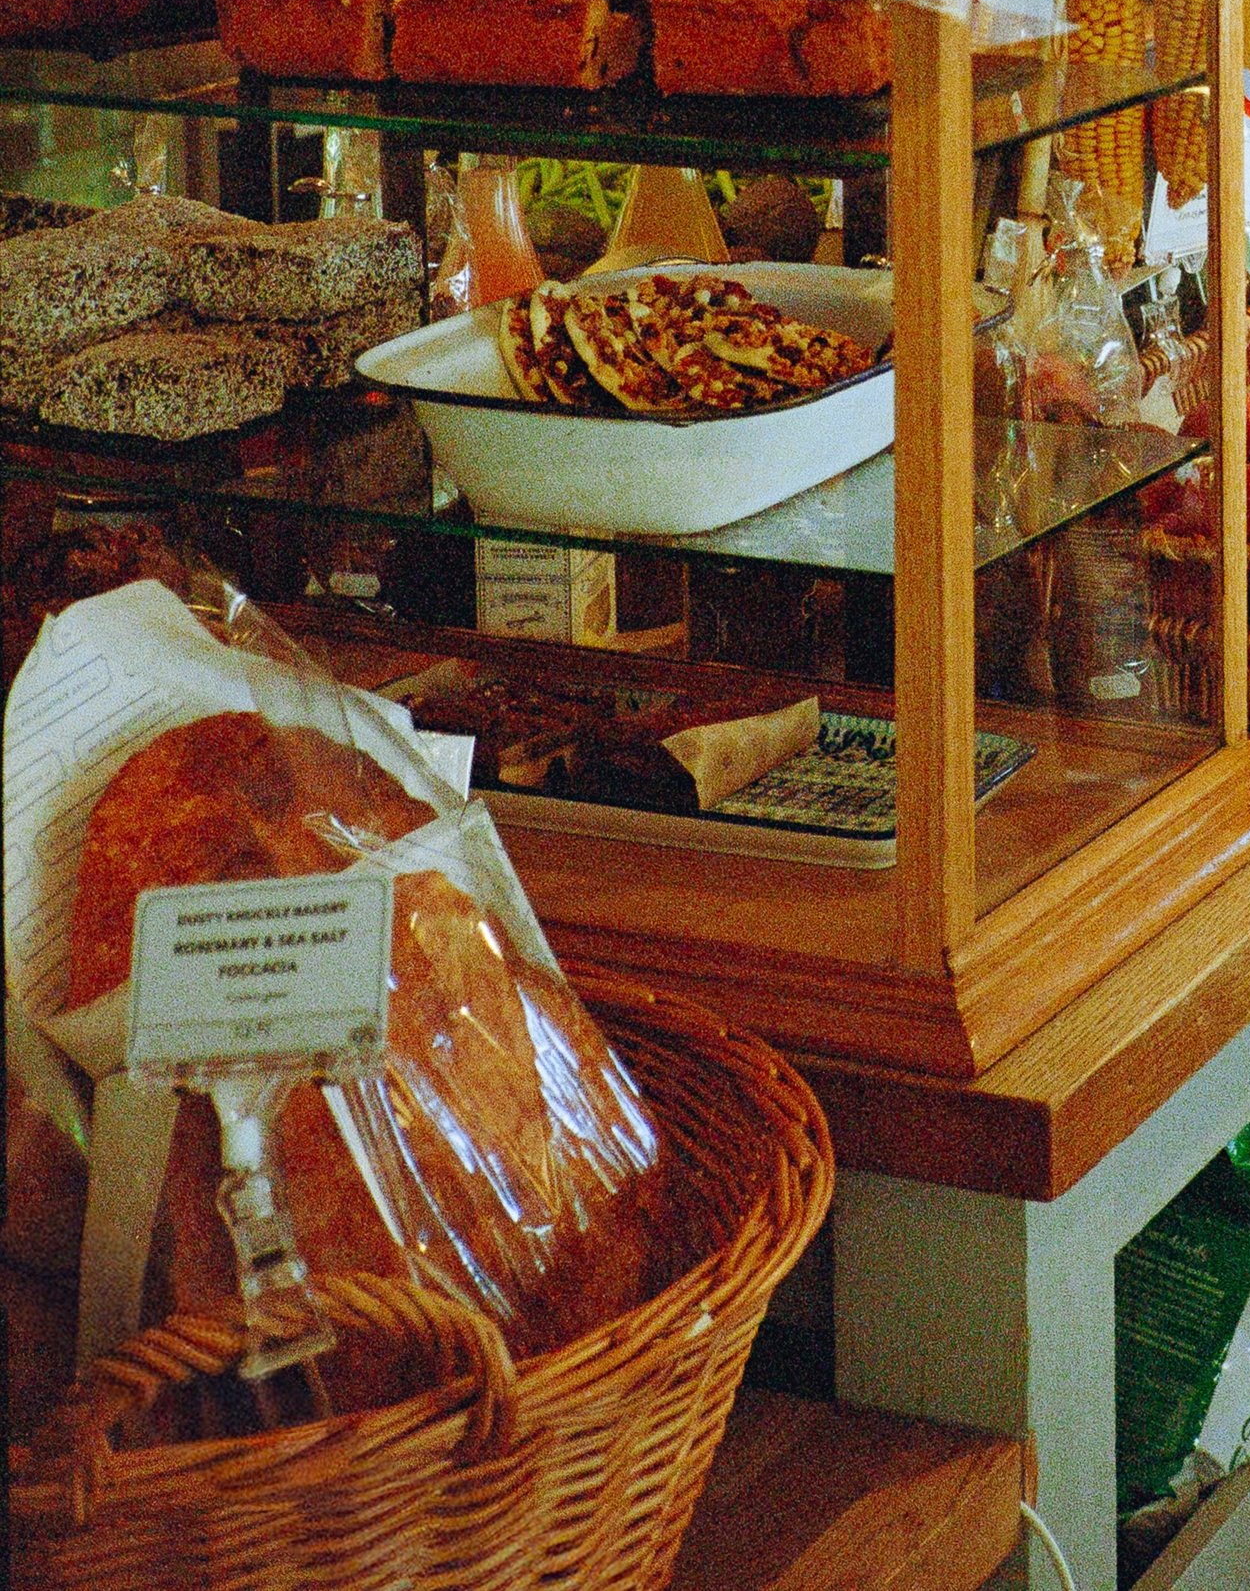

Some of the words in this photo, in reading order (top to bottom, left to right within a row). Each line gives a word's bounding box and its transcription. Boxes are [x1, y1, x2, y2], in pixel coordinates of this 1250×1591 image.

[173, 936, 259, 955] ROSEMARY
[278, 930, 306, 947] SEA
[311, 929, 348, 945] SALT
